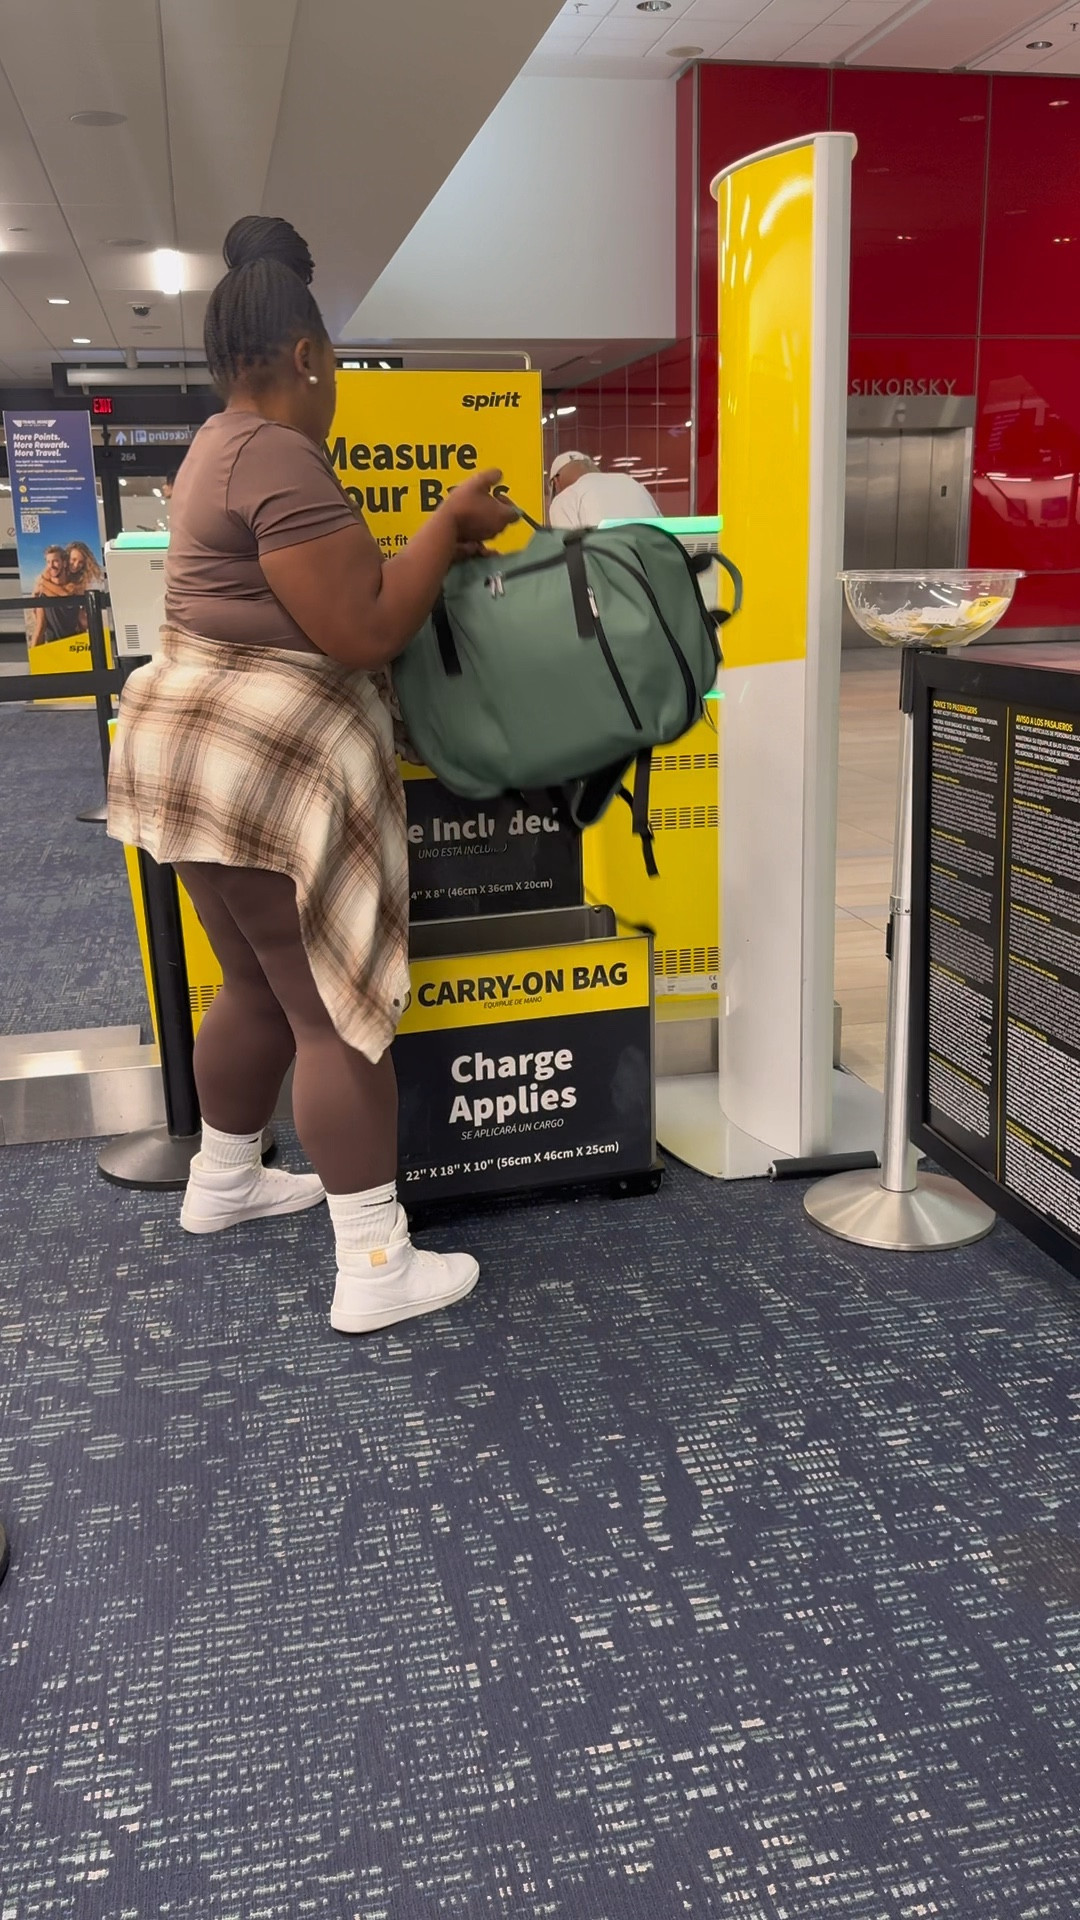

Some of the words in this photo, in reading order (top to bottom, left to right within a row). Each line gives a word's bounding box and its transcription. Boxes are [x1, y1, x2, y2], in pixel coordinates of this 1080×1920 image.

[851, 379, 957, 396] SIKORSKY
[462, 392, 521, 411] spirit
[13, 433, 33, 441] More
[33, 432, 61, 441] Points.
[14, 441, 33, 449] More
[34, 440, 70, 449] Rewards.
[15, 449, 34, 457] More
[35, 449, 62, 457] Travel.
[339, 479, 408, 513] our
[394, 534, 409, 547] fit
[1016, 714, 1029, 724] AVISO
[1035, 718, 1043, 727] LOS
[1044, 720, 1073, 732] PASAJEROS
[418, 848, 439, 859] UNO
[425, 890, 432, 899] X
[448, 887, 478, 898] (46cm
[479, 885, 486, 894] X
[488, 883, 514, 893] 36cm
[516, 881, 522, 890] X
[524, 878, 553, 890] 20cm)
[418, 968, 564, 1007] CARRY-ON
[572, 962, 628, 990] BAG
[484, 998, 513, 1009] EQUIPAJE
[514, 998, 523, 1006] DE
[524, 996, 543, 1005] MANO
[451, 1048, 573, 1083] Charge
[448, 1083, 577, 1127] Applies
[461, 1130, 473, 1141] SE
[473, 1123, 517, 1139] APLICARÁ
[519, 1123, 532, 1133] UN
[533, 1118, 564, 1131] CARGO
[406, 1169, 427, 1181] 22"
[429, 1167, 438, 1178] X
[440, 1164, 460, 1177] 18"
[463, 1162, 471, 1173] X
[473, 1159, 494, 1172] 10"
[497, 1154, 532, 1170] (56cm
[533, 1152, 542, 1163] X
[543, 1149, 574, 1161] 46cm
[575, 1146, 584, 1157] X
[585, 1141, 620, 1156] 25cm)
